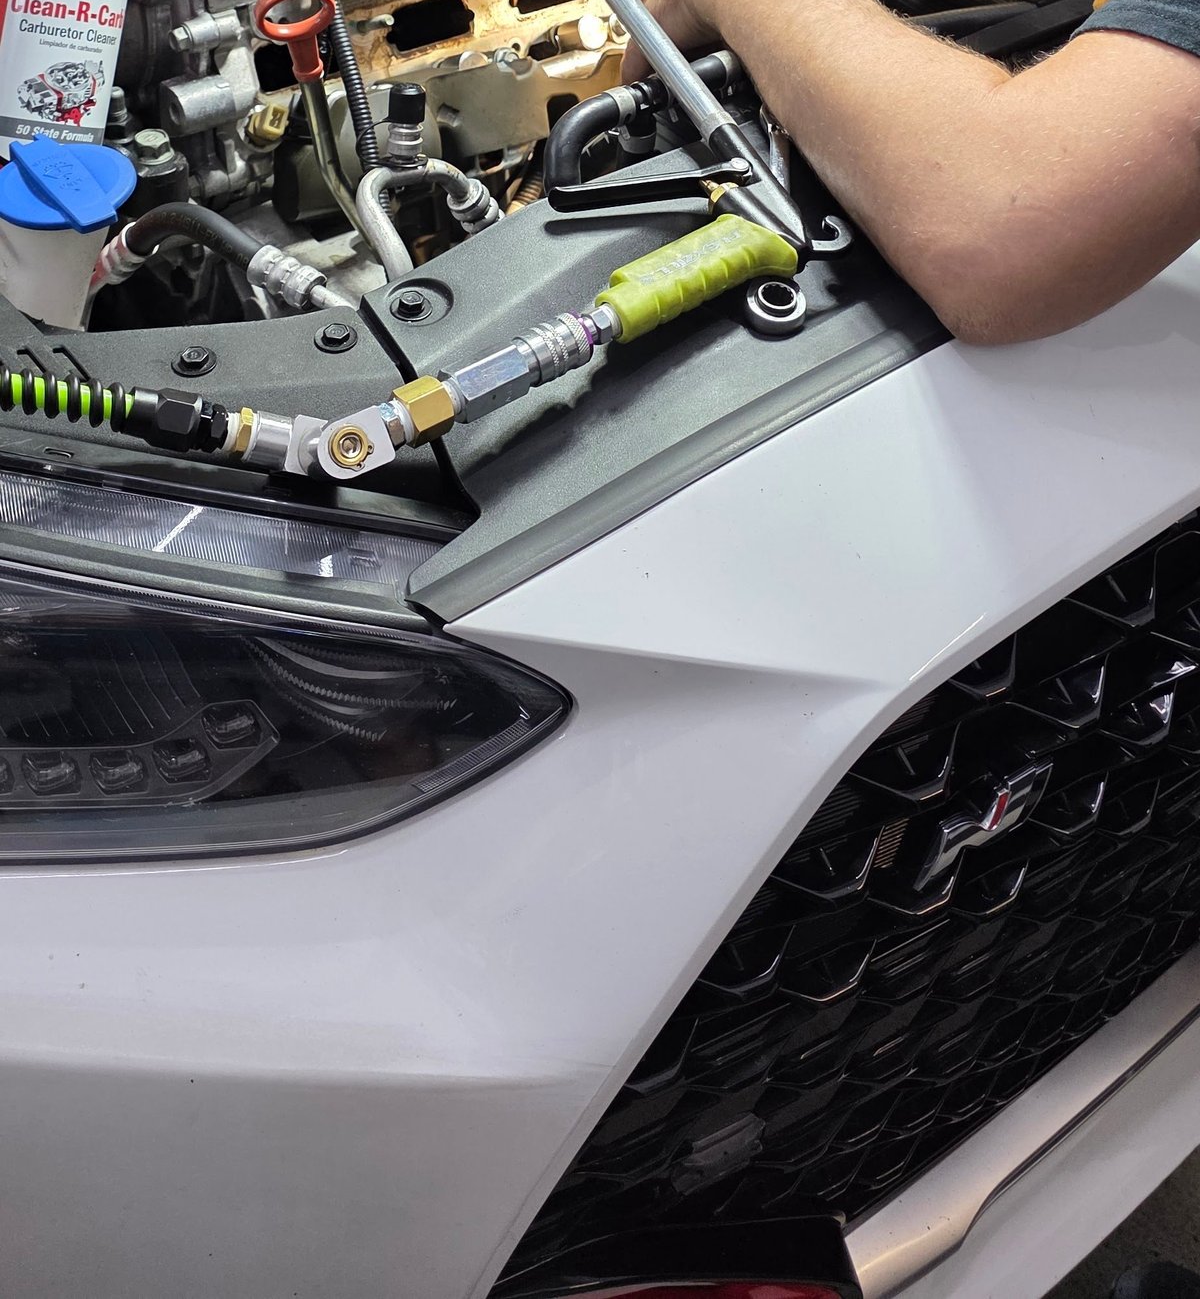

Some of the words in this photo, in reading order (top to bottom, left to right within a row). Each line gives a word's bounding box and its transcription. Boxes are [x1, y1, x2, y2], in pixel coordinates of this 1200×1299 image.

[19, 19, 84, 40] Carburetor
[86, 29, 117, 45] Cleaner
[15, 124, 31, 135] 50
[31, 126, 60, 139] State
[60, 130, 94, 143] Formula
